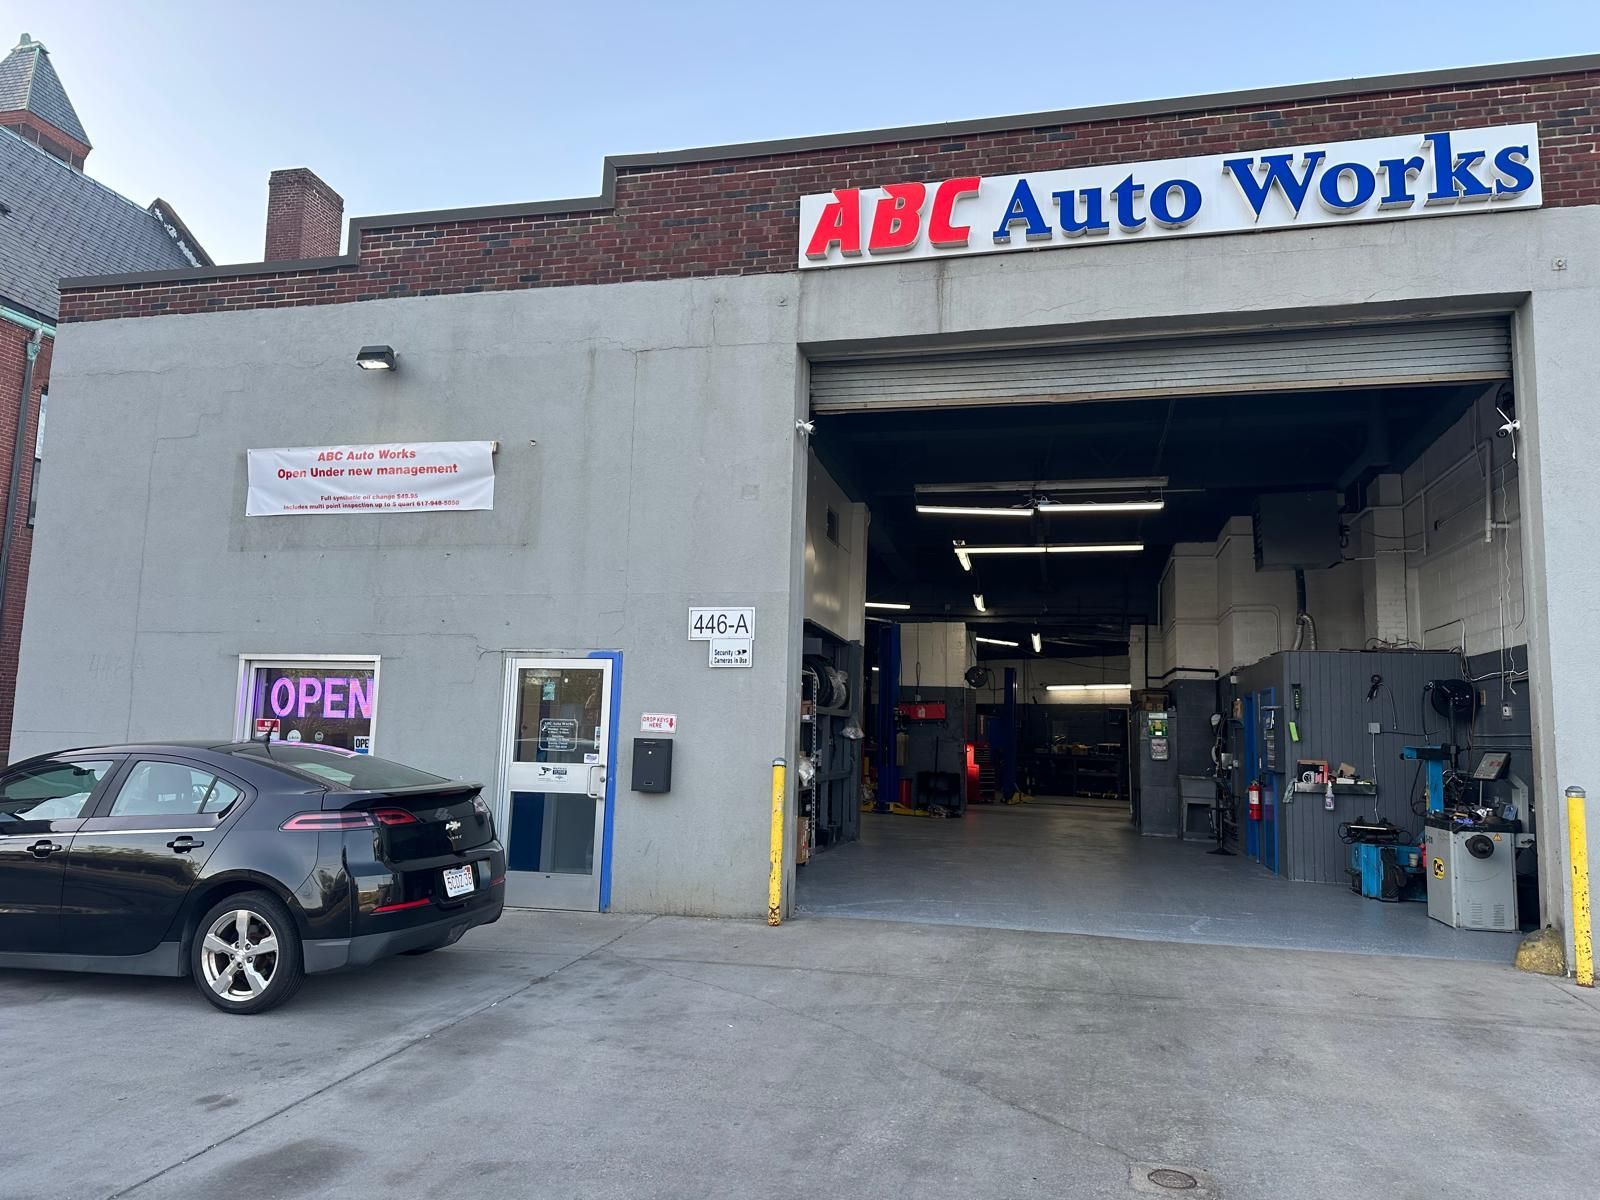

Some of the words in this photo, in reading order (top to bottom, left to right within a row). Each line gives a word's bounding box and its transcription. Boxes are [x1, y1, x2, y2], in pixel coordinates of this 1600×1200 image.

[805, 176, 982, 260] ABC
[993, 172, 1202, 245] Auto
[1221, 132, 1535, 223] Works
[318, 451, 343, 462] ABC
[346, 450, 374, 461] Auto
[379, 448, 416, 459] Works
[277, 468, 306, 480] Open
[310, 467, 344, 478] Under
[348, 467, 373, 476] new
[377, 463, 458, 476] management
[693, 613, 749, 634] 446-A
[714, 649, 733, 657] Security
[271, 677, 374, 719] OPEN
